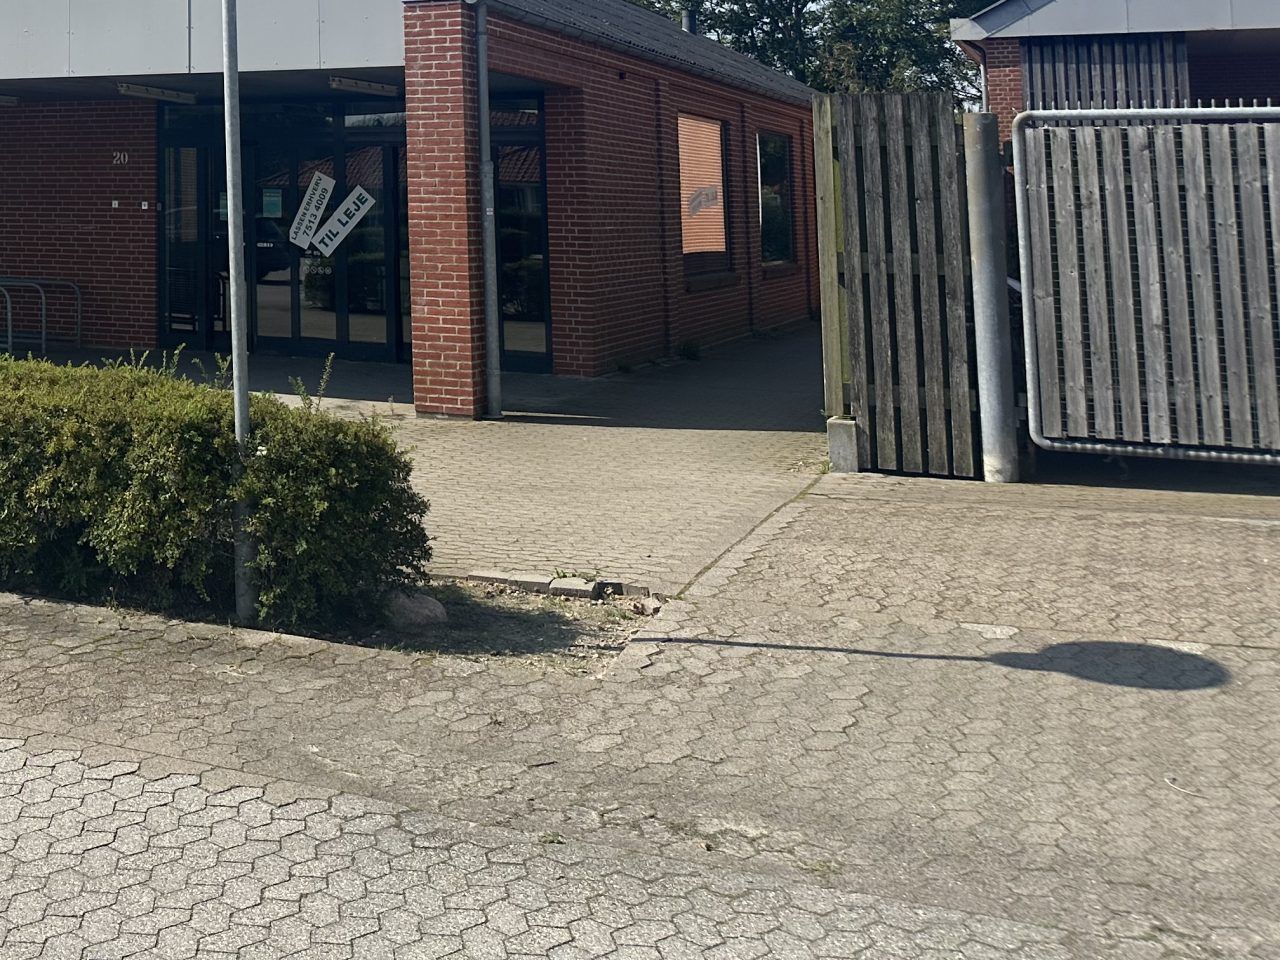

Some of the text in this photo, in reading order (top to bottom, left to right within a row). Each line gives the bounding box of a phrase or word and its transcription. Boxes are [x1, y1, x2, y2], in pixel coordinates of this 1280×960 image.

[112, 151, 129, 165] 20
[291, 176, 322, 241] LASSEN ERHVERV
[302, 213, 318, 238] 7513
[314, 187, 329, 212] 4009
[319, 192, 369, 248] TIL LEJE
